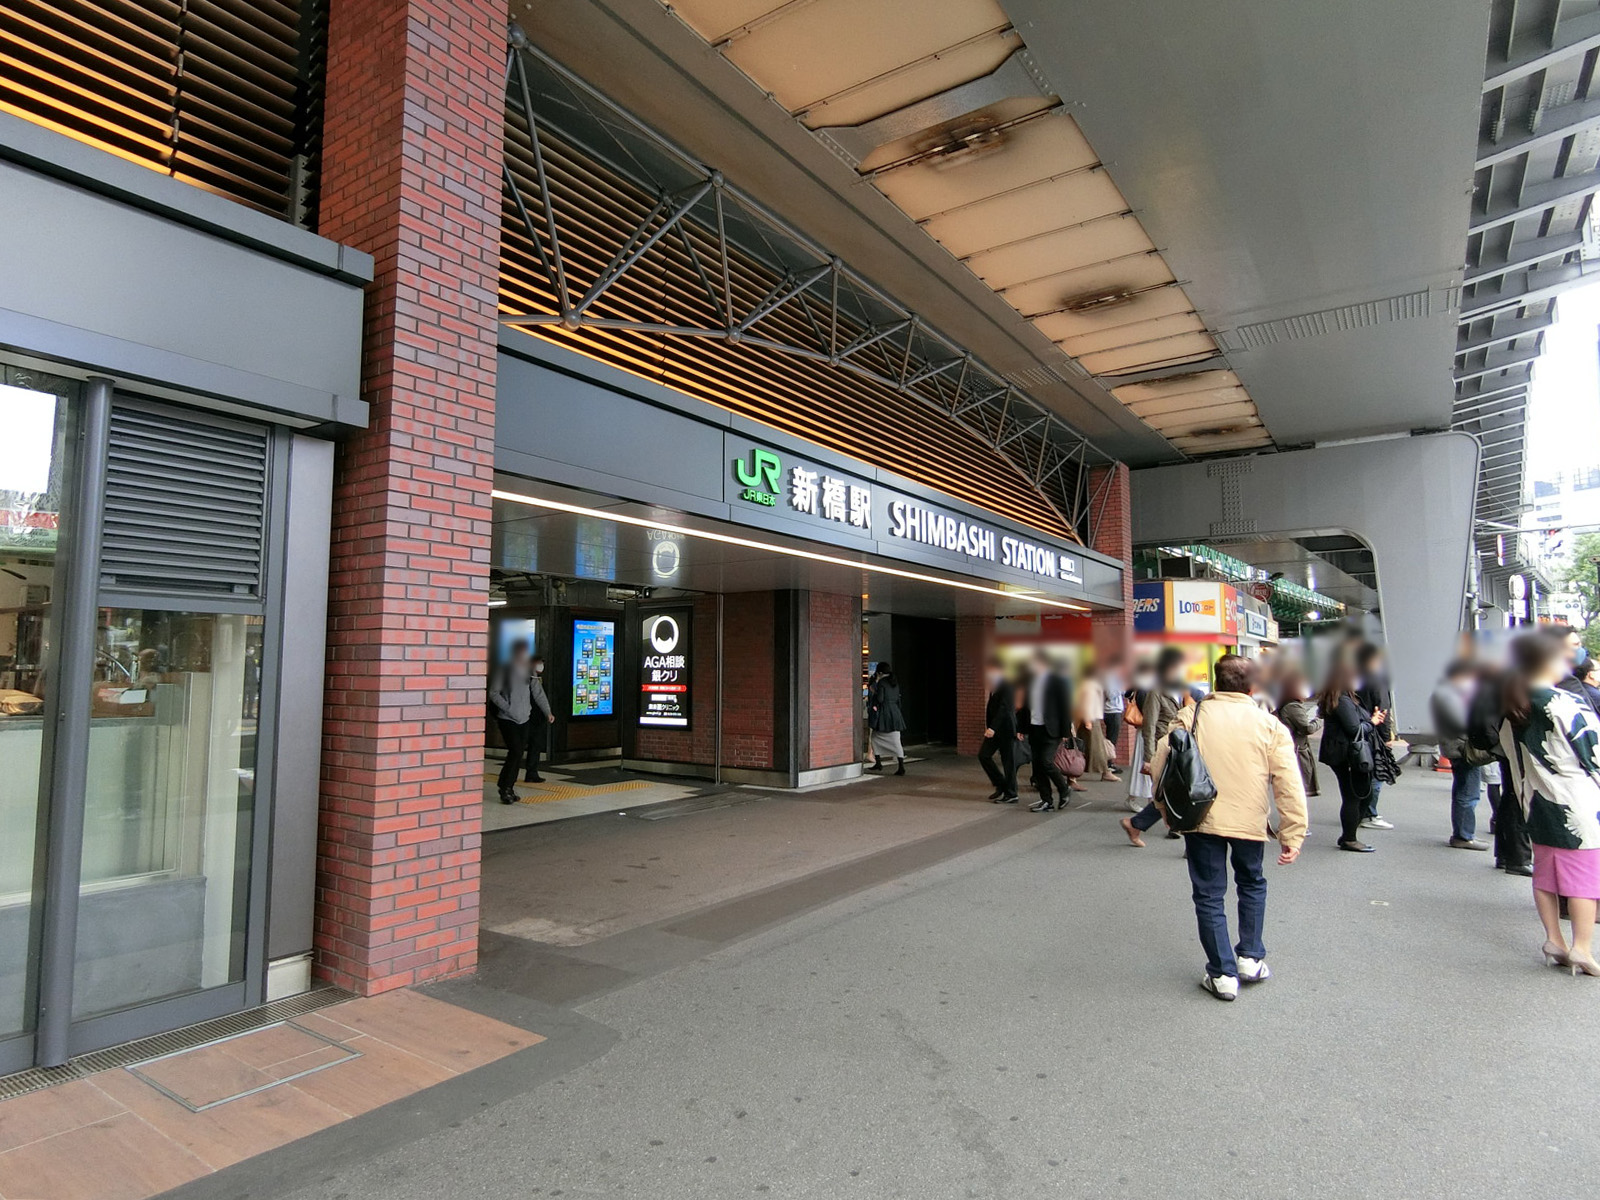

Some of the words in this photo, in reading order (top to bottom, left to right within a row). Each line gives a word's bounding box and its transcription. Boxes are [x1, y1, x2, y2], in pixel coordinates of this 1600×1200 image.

[736, 448, 781, 494] JR
[743, 488, 776, 507] JR東日本
[791, 466, 871, 529] 新橋駅
[892, 500, 995, 561] SHIMBASHI
[1001, 535, 1056, 578] STATION
[1179, 600, 1200, 614] LOTO
[643, 655, 685, 668] AGA相談
